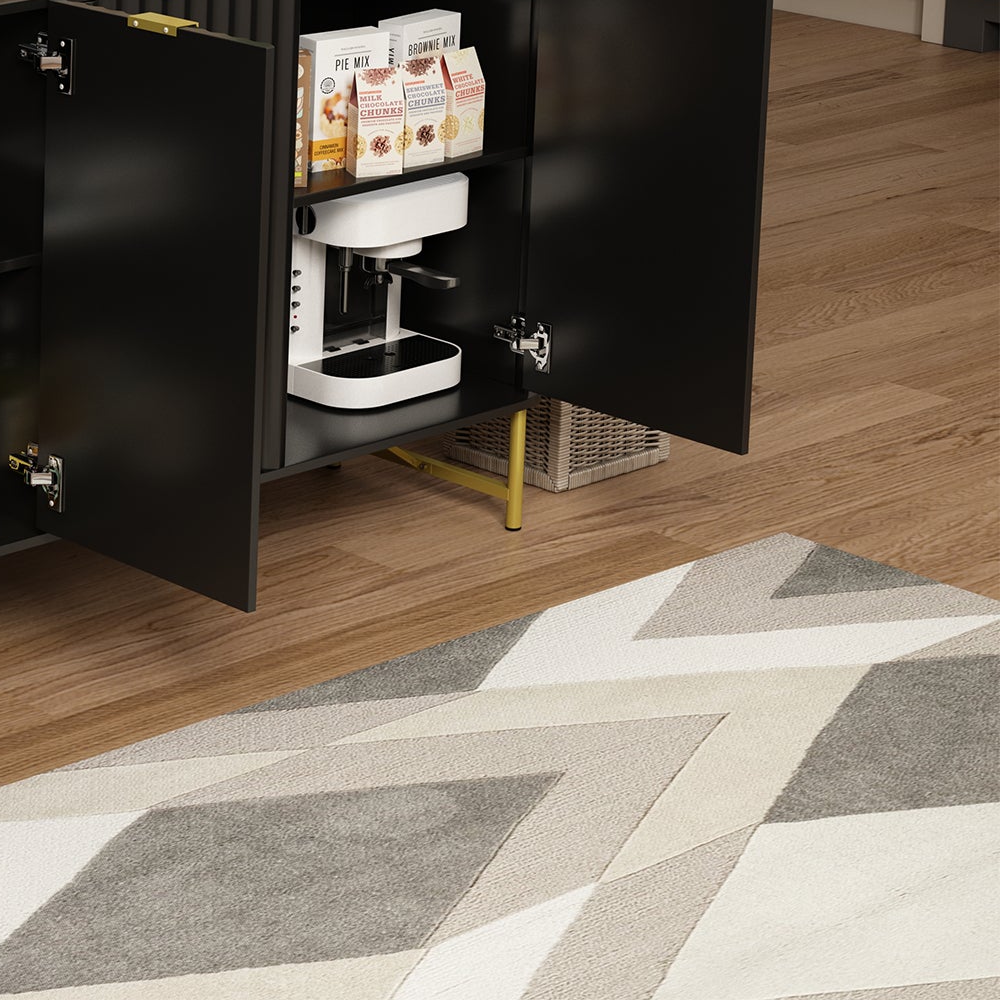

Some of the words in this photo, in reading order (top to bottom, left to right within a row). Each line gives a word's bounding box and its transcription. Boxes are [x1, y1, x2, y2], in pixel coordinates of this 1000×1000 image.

[408, 38, 440, 56] BROWNIE
[443, 35, 456, 48] MIX
[335, 58, 349, 72] PIE
[353, 56, 370, 69] MIX
[452, 74, 473, 84] WHITE
[454, 78, 484, 90] CHOCOLATE
[406, 83, 443, 93] SEMISWEET
[455, 85, 484, 97] CHUNKS
[407, 89, 445, 99] CHOCOLATE
[408, 96, 445, 107] CHUNKS
[360, 107, 403, 117] CHUNKS
